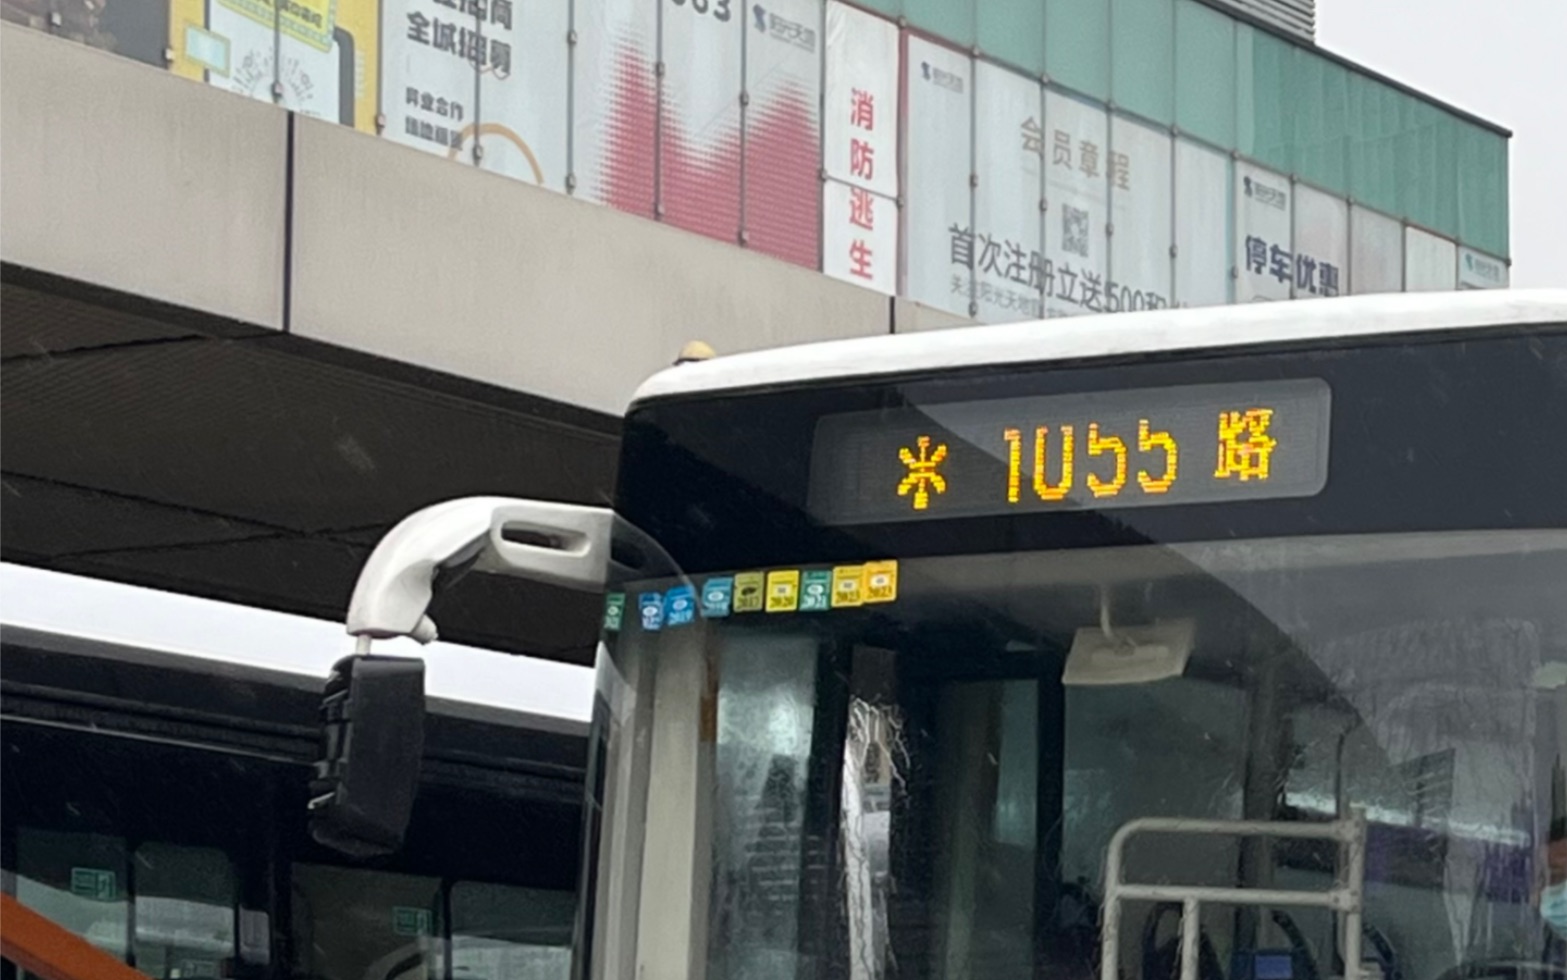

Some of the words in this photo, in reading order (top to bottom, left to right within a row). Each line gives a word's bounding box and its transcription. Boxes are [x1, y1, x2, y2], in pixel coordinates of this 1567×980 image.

[849, 87, 874, 280] 消防逃生
[948, 223, 1187, 313] 首次注册立送500
[1246, 235, 1340, 298] 停车优惠
[1004, 419, 1177, 503] 1055
[1214, 408, 1276, 480] 路
